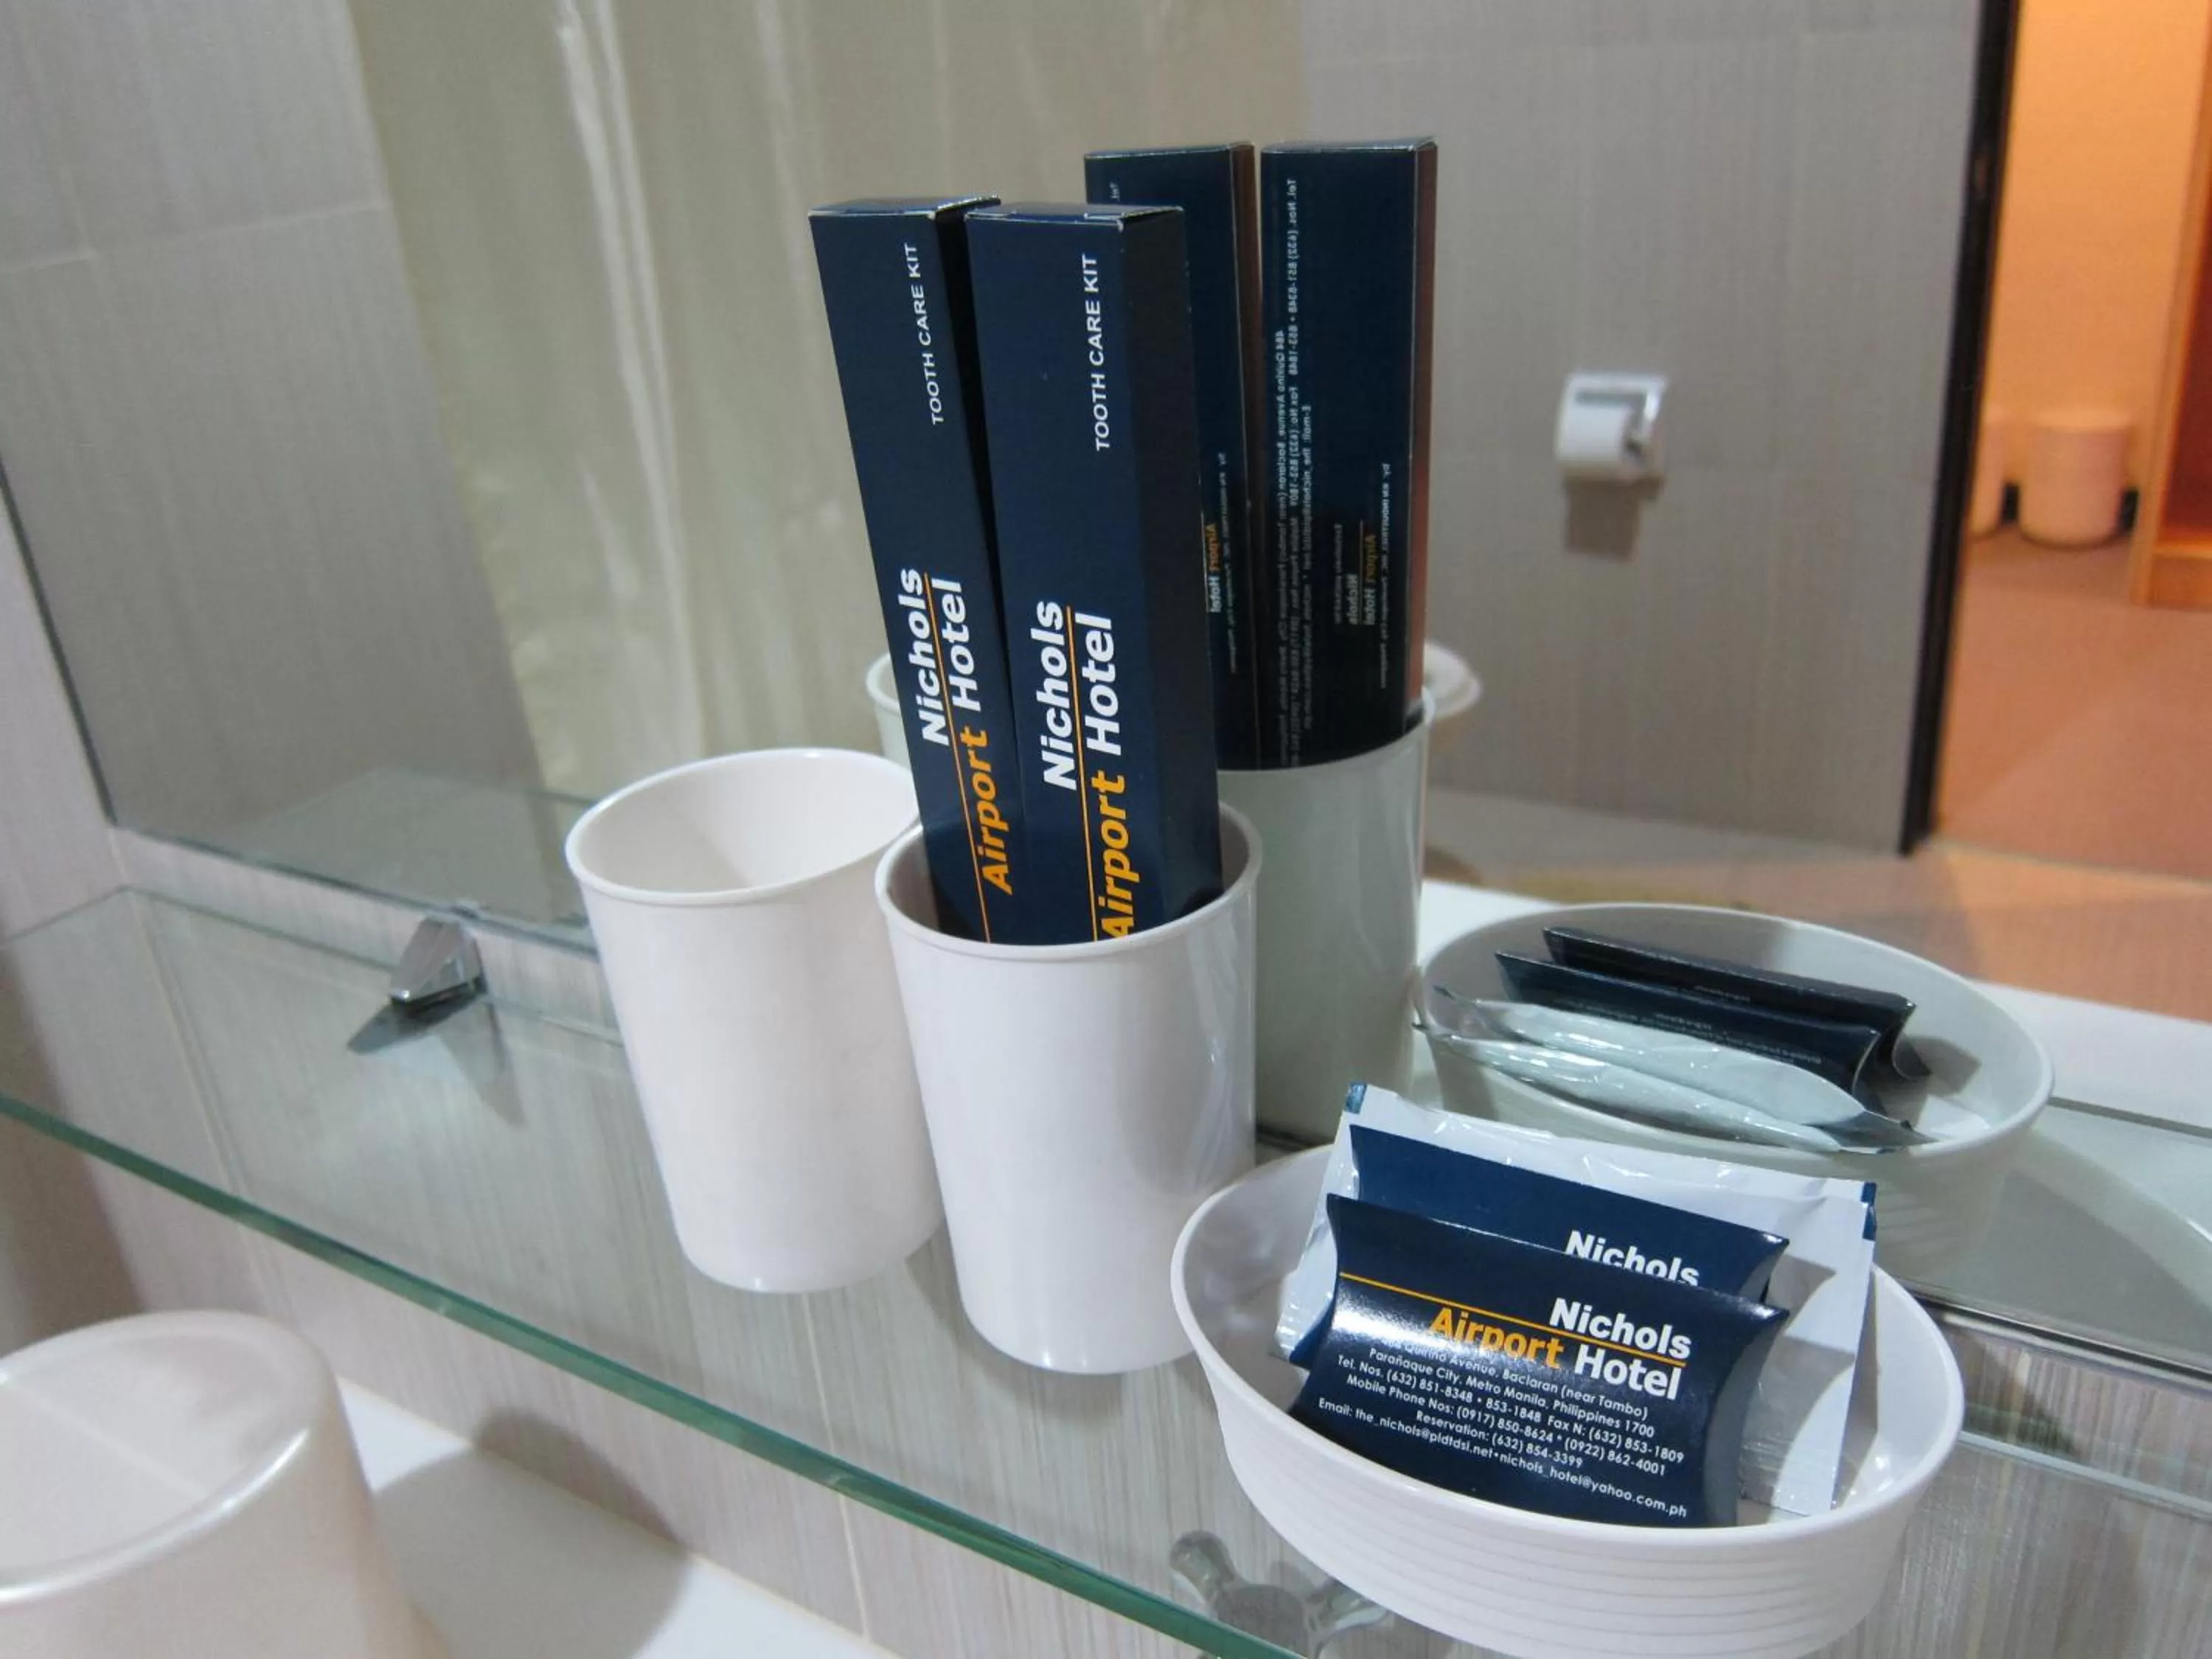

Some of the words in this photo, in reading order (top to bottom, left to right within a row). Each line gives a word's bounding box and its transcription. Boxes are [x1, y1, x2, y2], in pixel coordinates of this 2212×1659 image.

[904, 242, 921, 278] KIT
[1082, 253, 1099, 292] KIT
[911, 284, 931, 346] CARE
[1085, 300, 1104, 366] CARE
[922, 353, 944, 425] TOOTH
[1091, 372, 1110, 451] TOOTH
[898, 568, 950, 747] Nichols
[931, 577, 981, 712] Hotel
[1030, 600, 1077, 790] Nichols
[1075, 613, 1121, 757] Hotel
[960, 726, 1012, 896] Airport
[1091, 770, 1140, 941] Airport
[1565, 1228, 1700, 1287] Nichols
[1430, 1306, 1564, 1369] Airport
[1574, 1343, 1682, 1400] Hotel
[1549, 1297, 1692, 1359] Nichols
[1318, 1398, 1353, 1415] Email:
[1338, 1355, 1355, 1370] Tel.
[1360, 1361, 1383, 1377] Nos.
[1386, 1369, 1416, 1388] (632)
[1419, 1378, 1473, 1403] 851-8348
[1486, 1398, 1542, 1423] 853-1848
[1548, 1415, 1569, 1430] Fax
[1573, 1422, 1585, 1437] N:
[1589, 1427, 1622, 1448] (632)
[1624, 1438, 1684, 1463] 853-1809
[1346, 1374, 1387, 1394] Mobile
[1388, 1388, 1425, 1406] Phone
[1429, 1397, 1455, 1414] Nos:
[1456, 1405, 1495, 1428] (0917)
[1498, 1418, 1554, 1443] 850-8624
[1564, 1437, 1605, 1460] (0922)
[1607, 1452, 1666, 1476] 862-4001
[1368, 1348, 1433, 1376] Parañaque
[1466, 1378, 1500, 1394] Metro
[1553, 1399, 1621, 1428] Philippines
[1625, 1419, 1655, 1438] 1700
[1503, 1368, 1558, 1394] Baclaran
[1561, 1385, 1596, 1405] (near
[1599, 1394, 1649, 1421] Tambo)
[1416, 1411, 1489, 1441] Reservation:
[1492, 1433, 1523, 1453] (632)
[1526, 1444, 1583, 1468] 854-3399
